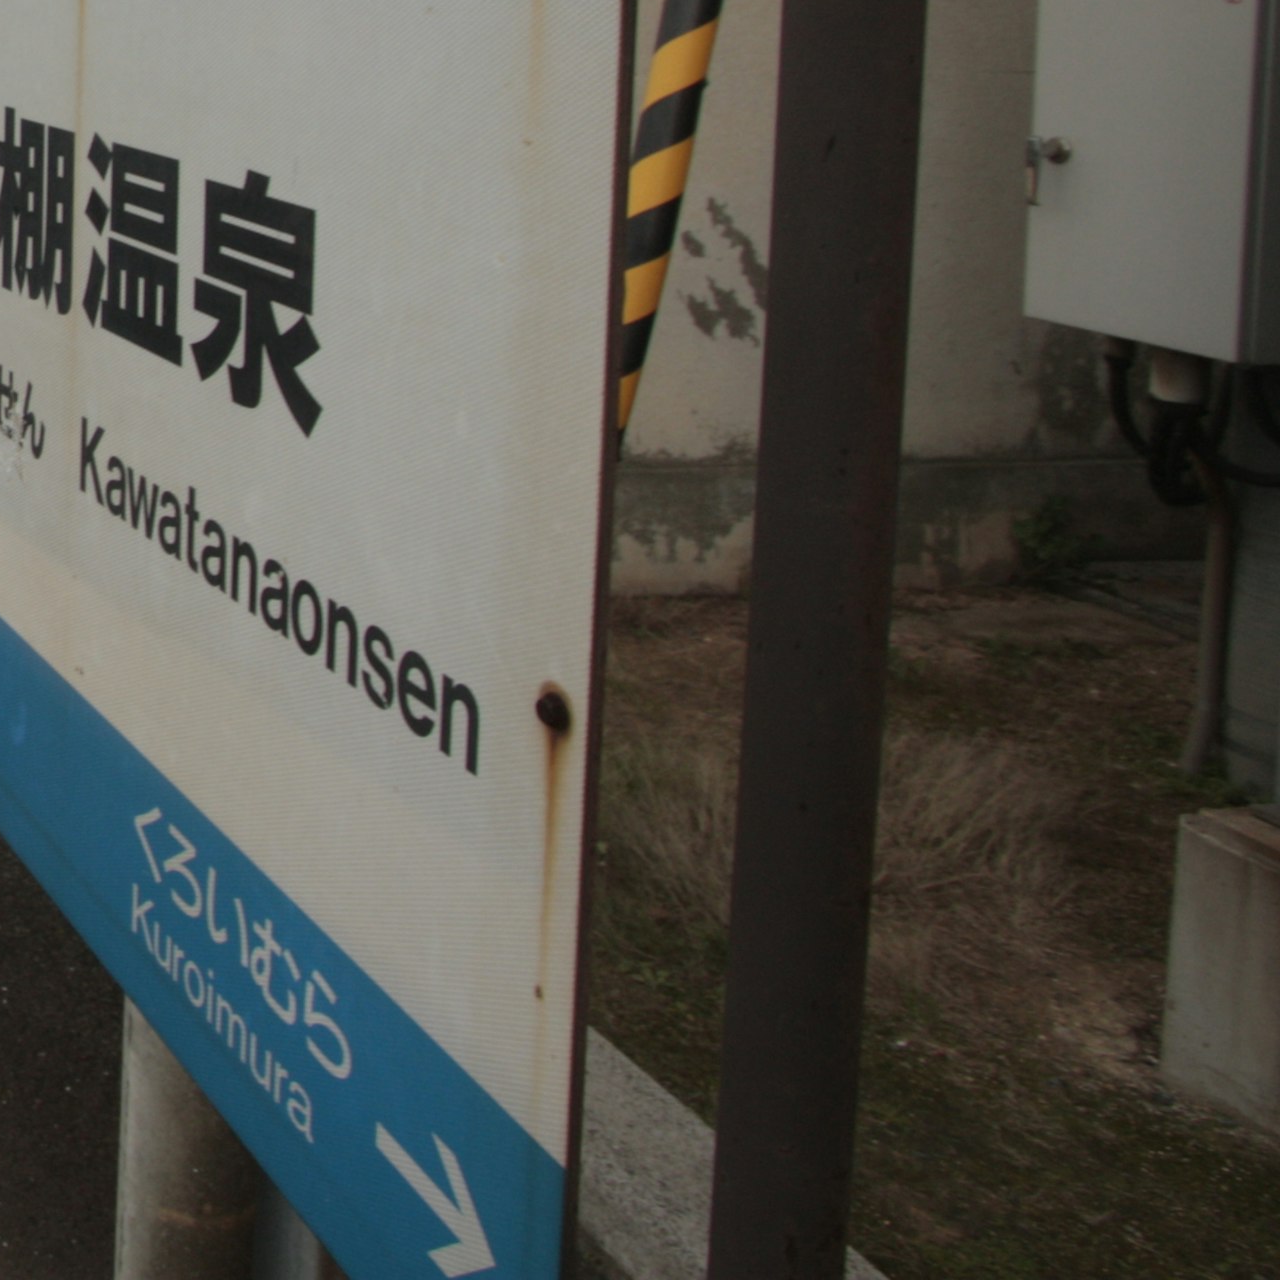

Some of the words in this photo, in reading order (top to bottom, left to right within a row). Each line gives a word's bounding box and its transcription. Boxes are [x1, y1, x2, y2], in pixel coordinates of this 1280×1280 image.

[80, 416, 480, 776] Kawatanaonsen
[130, 882, 316, 1145] Kuroimura
[132, 806, 353, 1081] くろいむら
